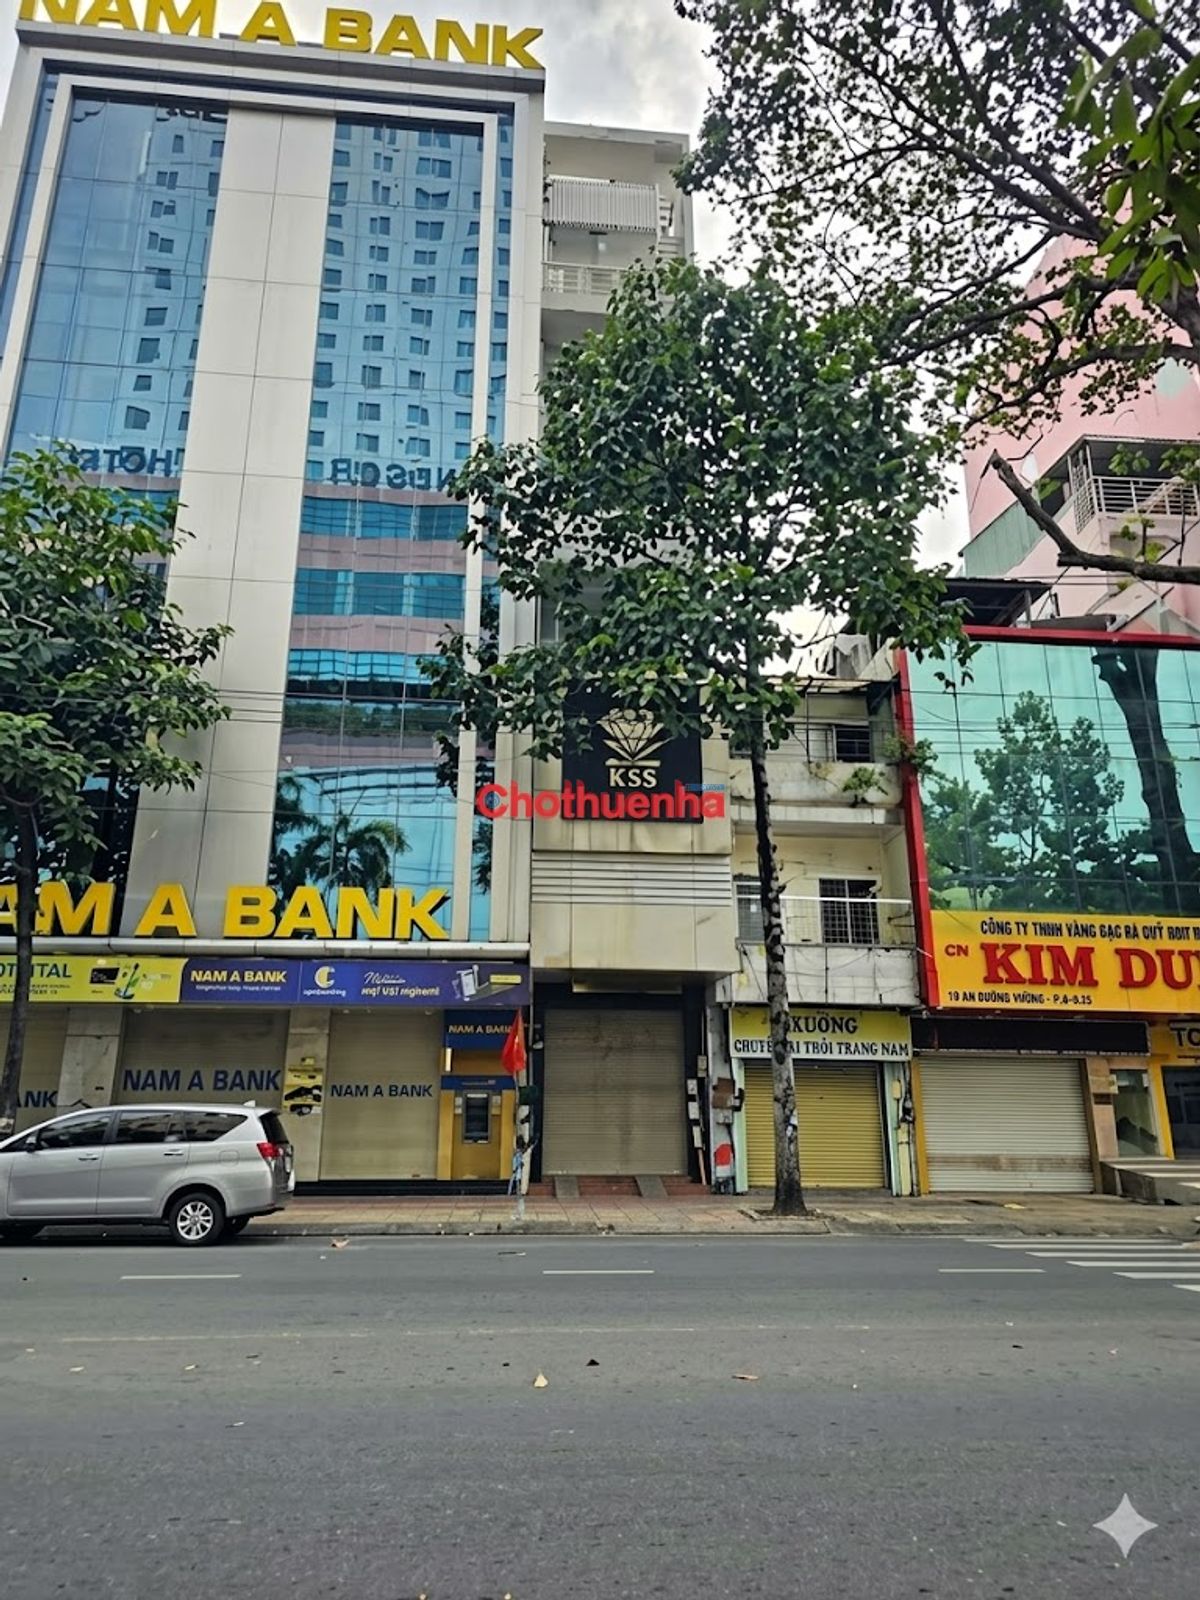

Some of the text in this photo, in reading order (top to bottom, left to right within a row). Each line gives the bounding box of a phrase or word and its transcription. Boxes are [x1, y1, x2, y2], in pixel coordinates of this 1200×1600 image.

[239, 1, 297, 46] A
[323, 8, 544, 70] BANK
[609, 768, 658, 788] KSS
[134, 883, 197, 936] A
[223, 885, 451, 939] BANK
[944, 942, 1200, 990] CN KIM DU
[190, 970, 288, 983] NAM A BANK
[448, 1024, 474, 1034] NAM
[837, 1042, 878, 1056] TRANG
[881, 1042, 909, 1056] NAM
[123, 1069, 282, 1091] NAM A BANK
[331, 1084, 433, 1098] NAM A BANK
